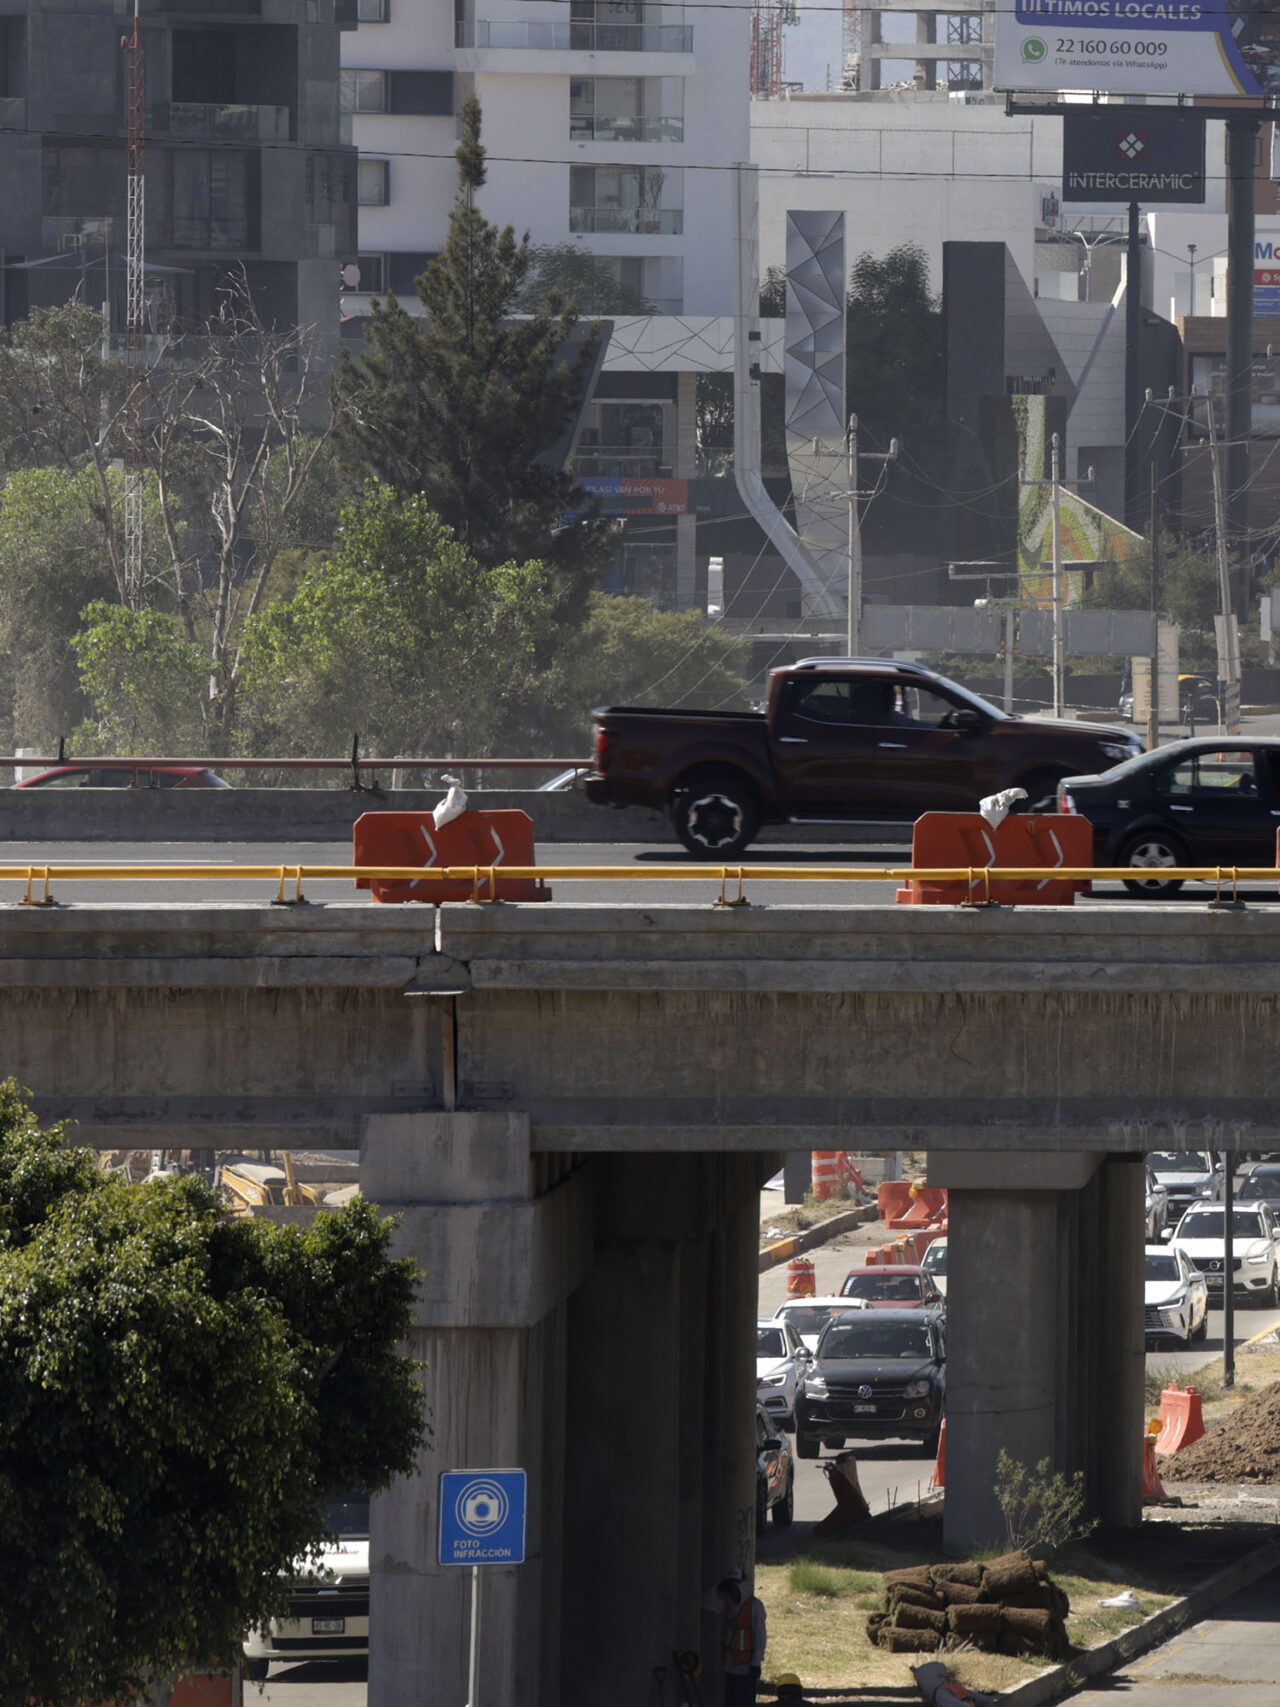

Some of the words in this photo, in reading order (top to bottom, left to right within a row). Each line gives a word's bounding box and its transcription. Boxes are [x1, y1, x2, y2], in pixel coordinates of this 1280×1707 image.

[1115, 3, 1202, 20] LOCALES
[1056, 38, 1075, 53] 22
[1080, 40, 1107, 54] 160
[1110, 41, 1131, 55] 60
[1134, 41, 1168, 56] 009
[1069, 59, 1111, 67] atendemos
[1069, 171, 1193, 190] INTERCERAMIC
[454, 1540, 480, 1549] FOTO
[453, 1548, 512, 1559] INFRACCIÓN
